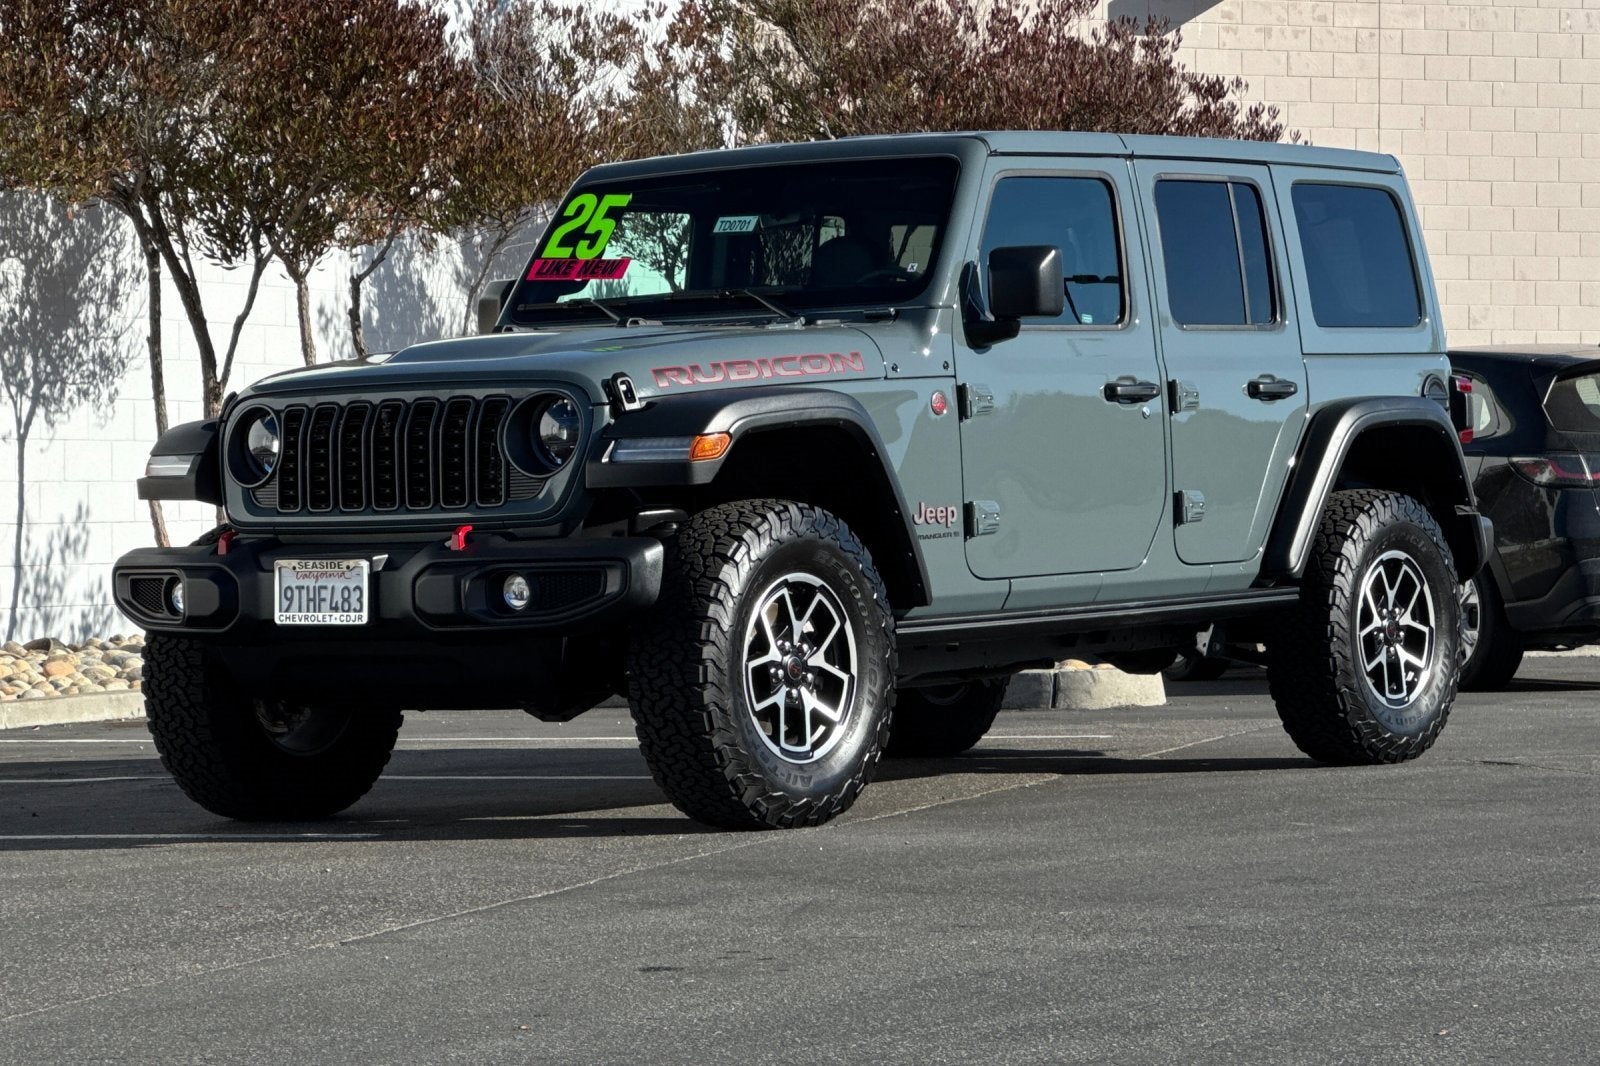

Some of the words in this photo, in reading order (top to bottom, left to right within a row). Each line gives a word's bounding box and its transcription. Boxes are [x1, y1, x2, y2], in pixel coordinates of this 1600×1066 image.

[541, 193, 631, 260] 25
[535, 260, 577, 276] LIKE
[578, 260, 624, 276] NEW
[652, 352, 865, 389] RUBICON
[912, 501, 958, 528] Jeep
[297, 561, 344, 570] SEASIDE
[296, 571, 352, 584] California
[283, 585, 363, 614] 9THF483
[278, 614, 334, 623] CHEVROLET
[338, 614, 364, 623] CDJR
